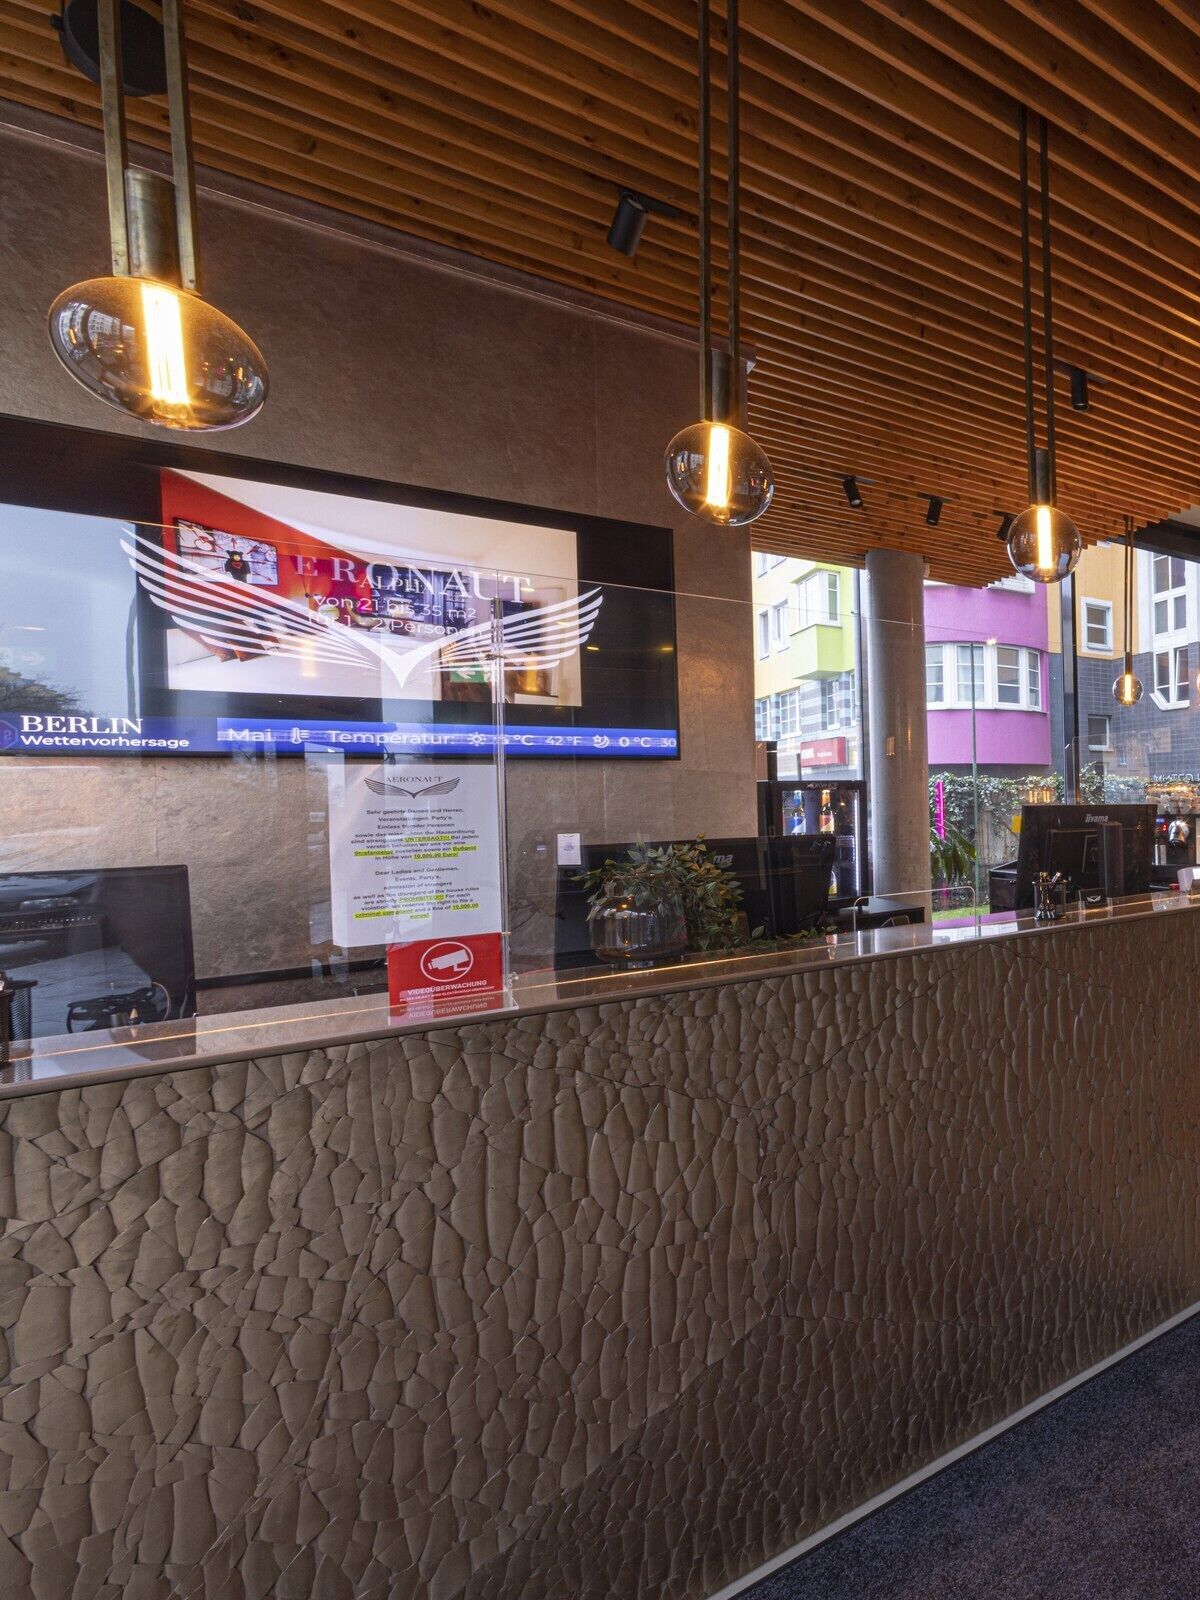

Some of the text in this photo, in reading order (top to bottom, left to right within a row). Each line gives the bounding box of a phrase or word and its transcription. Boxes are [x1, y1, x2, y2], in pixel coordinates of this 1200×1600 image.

[314, 596, 476, 619] von 21 bis 35 m2
[371, 618, 383, 632] 2
[391, 619, 482, 637] Personen
[20, 715, 143, 735] BERLIN
[20, 735, 190, 748] Wettervorhersage
[228, 727, 272, 742] Mai
[329, 730, 455, 745] Temperatur:
[545, 736, 563, 746] 42
[407, 980, 487, 996] VIDEOÜBERWACHUNG
